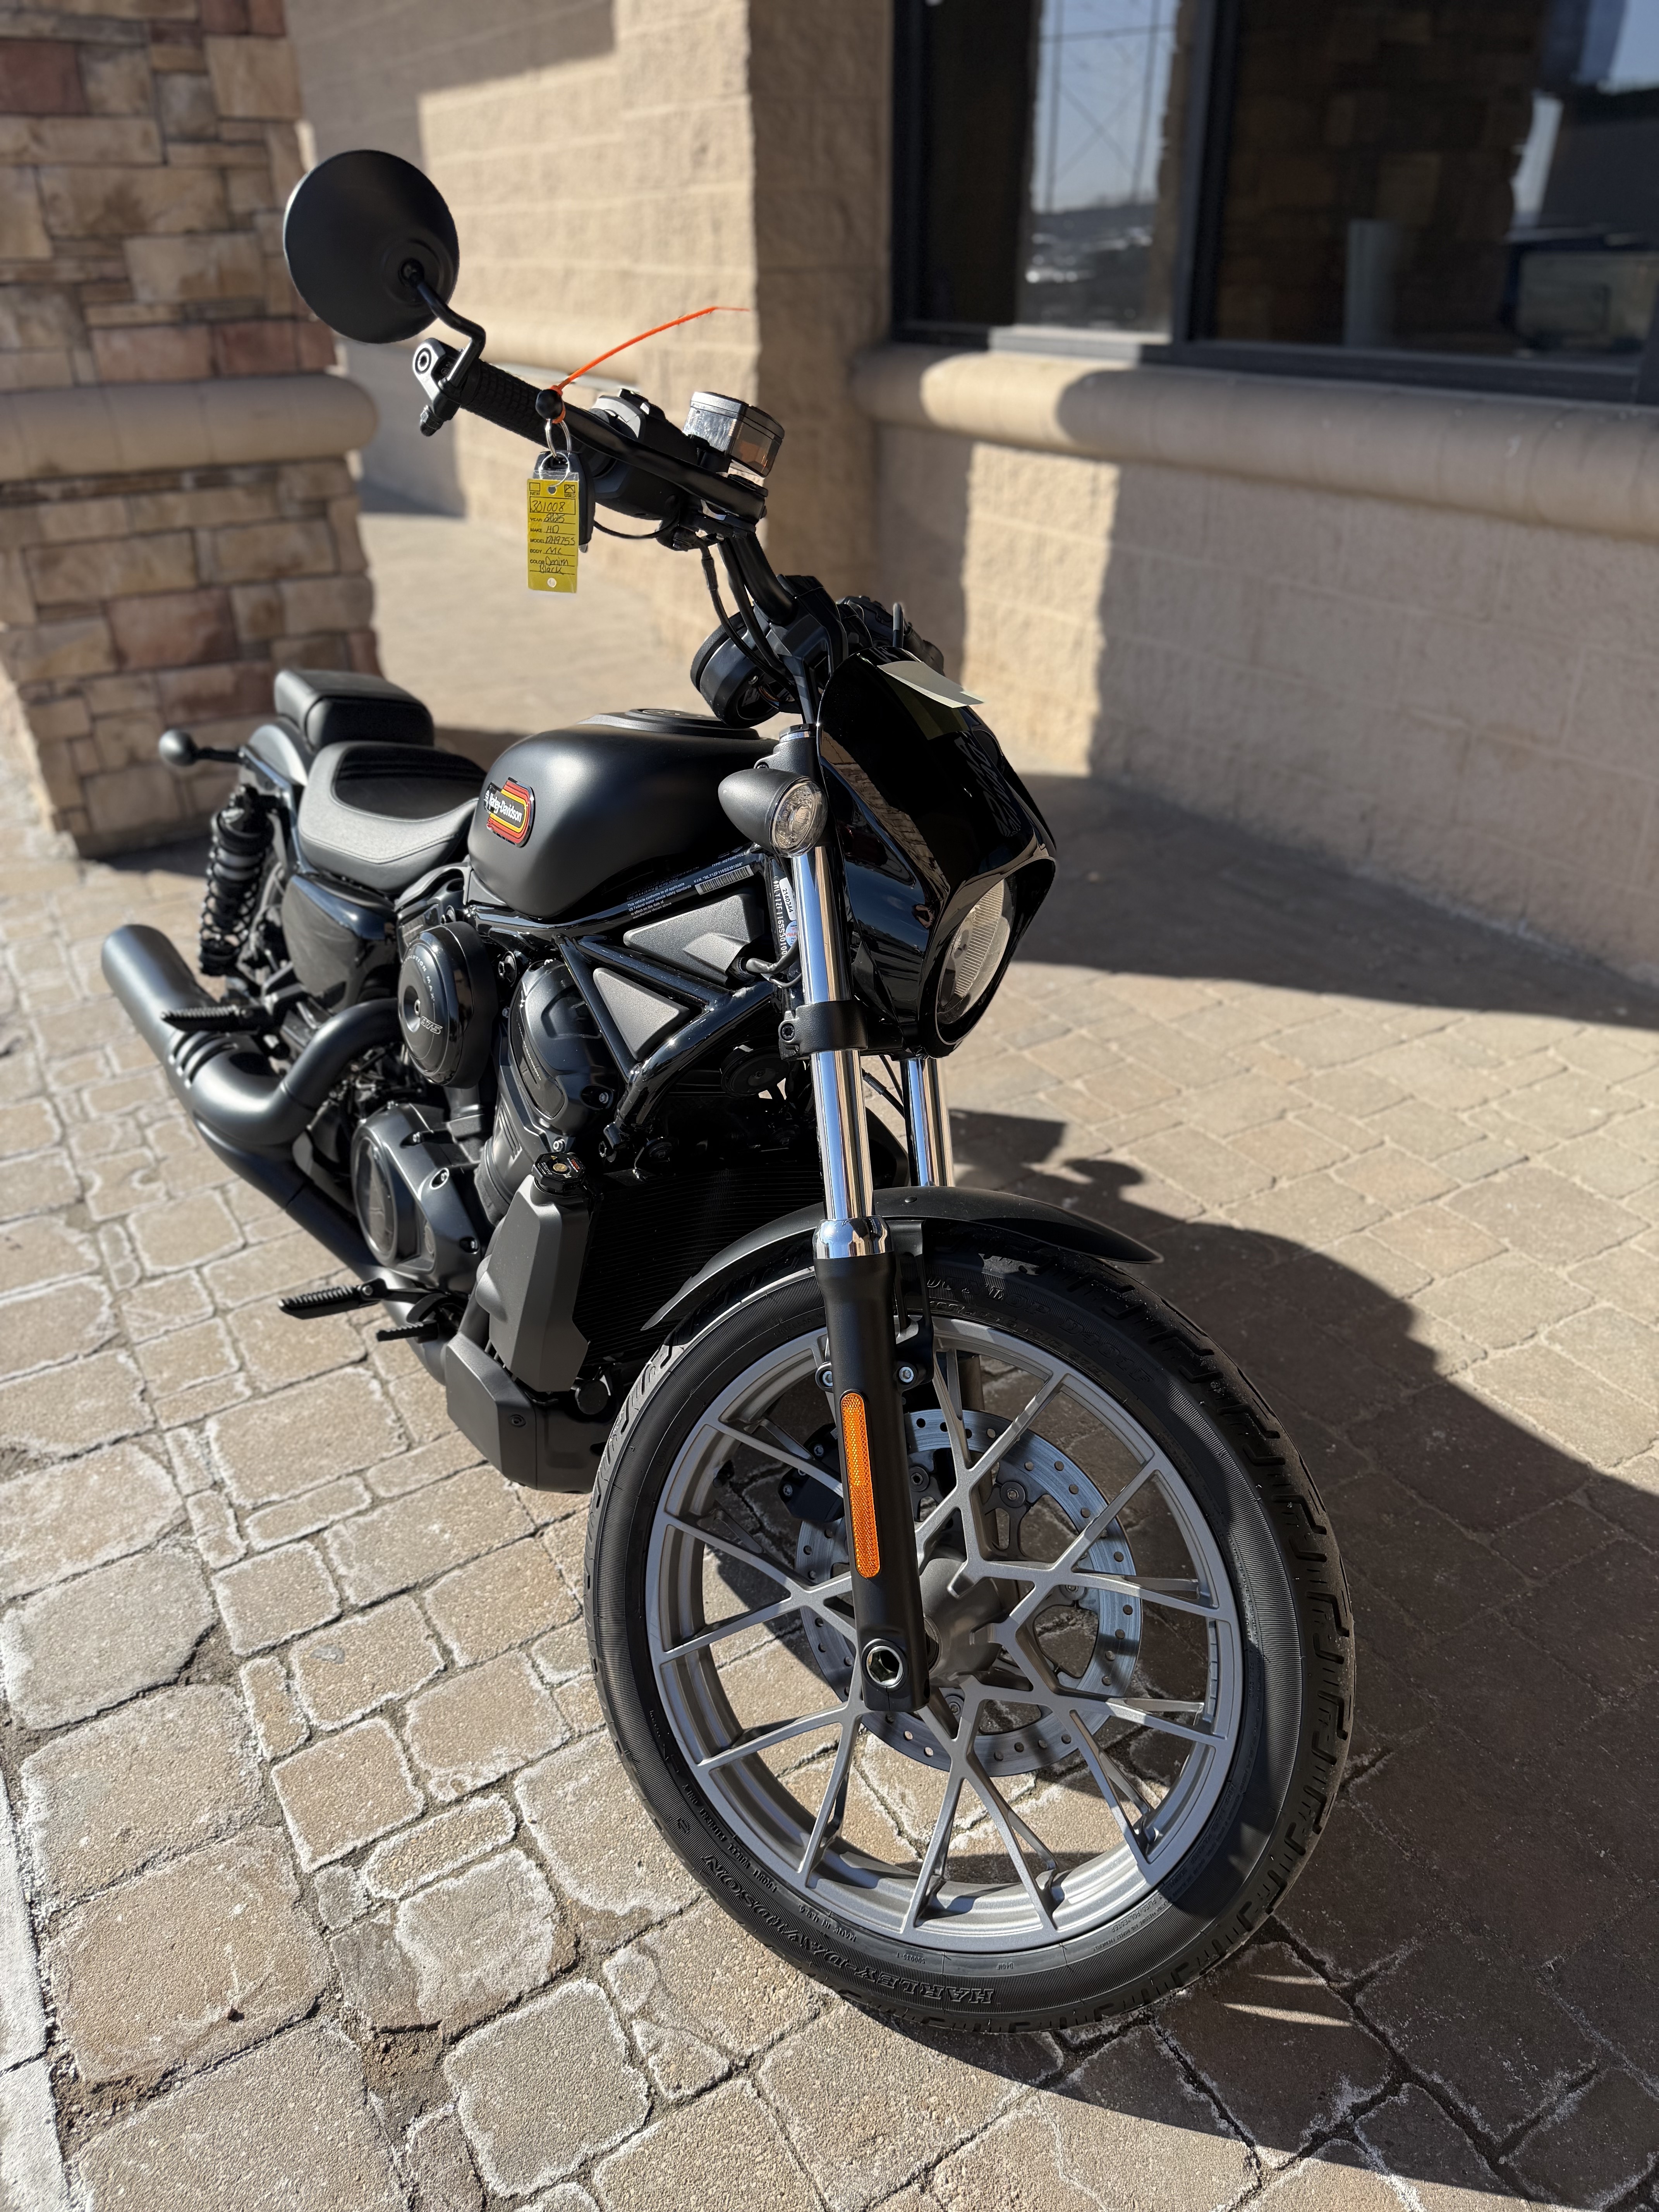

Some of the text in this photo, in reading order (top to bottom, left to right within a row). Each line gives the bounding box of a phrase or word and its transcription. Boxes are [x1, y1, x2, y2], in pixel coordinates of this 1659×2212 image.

[531, 500, 565, 512] 301008
[489, 793, 522, 823] Harley-Davidson
[782, 888, 793, 912] 2140344
[773, 884, 788, 956] MLY1ZF116SS30100
[420, 1015, 443, 1034] 975
[701, 1855, 994, 2004] HARLEY-DAVIDSON
